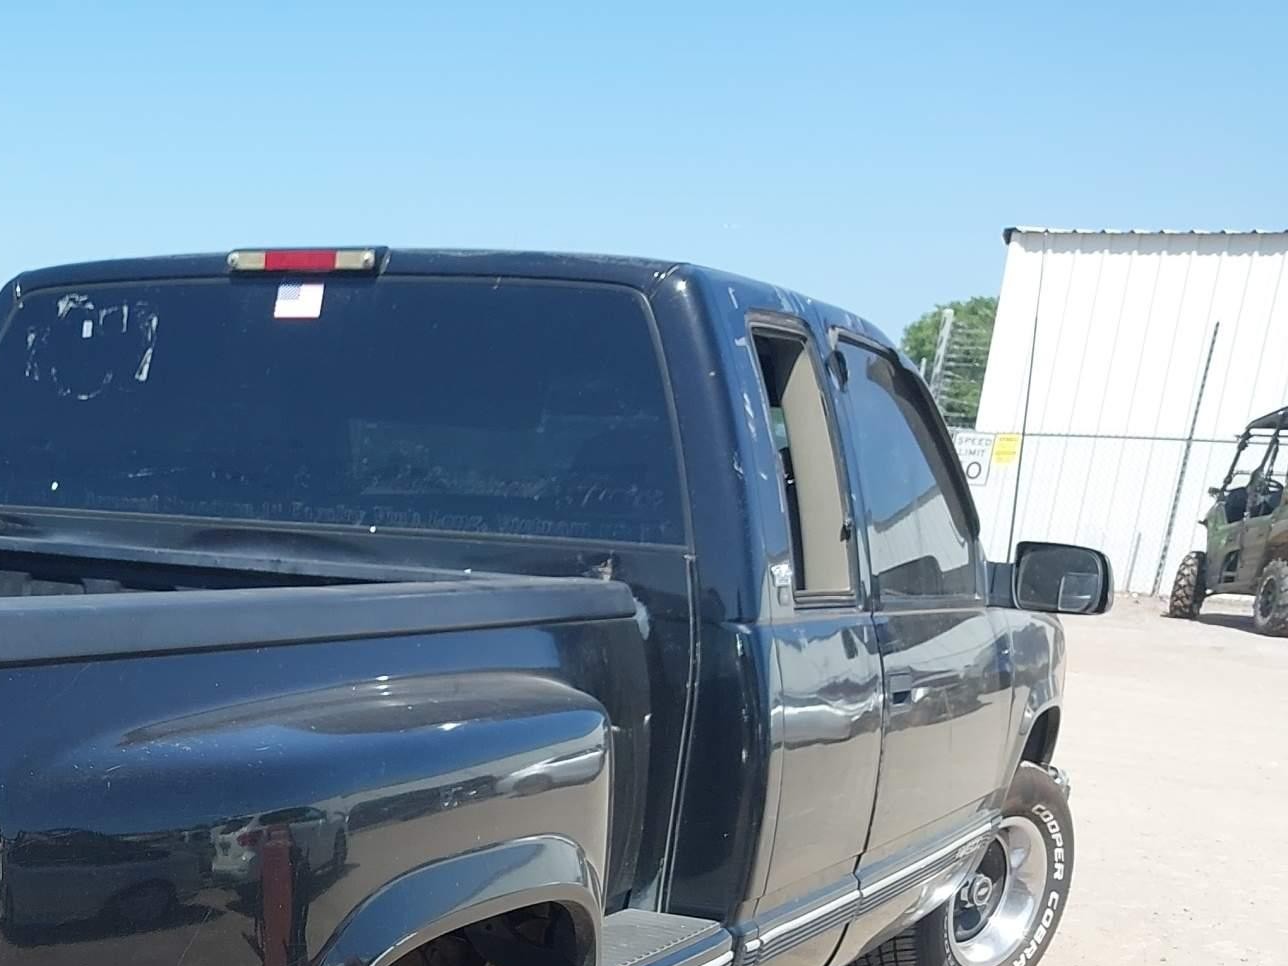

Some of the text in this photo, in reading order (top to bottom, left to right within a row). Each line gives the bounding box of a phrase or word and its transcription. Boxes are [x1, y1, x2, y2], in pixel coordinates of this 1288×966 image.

[958, 436, 992, 446] SPEED
[959, 448, 985, 457] LIMIT
[1032, 804, 1064, 881] COOPER
